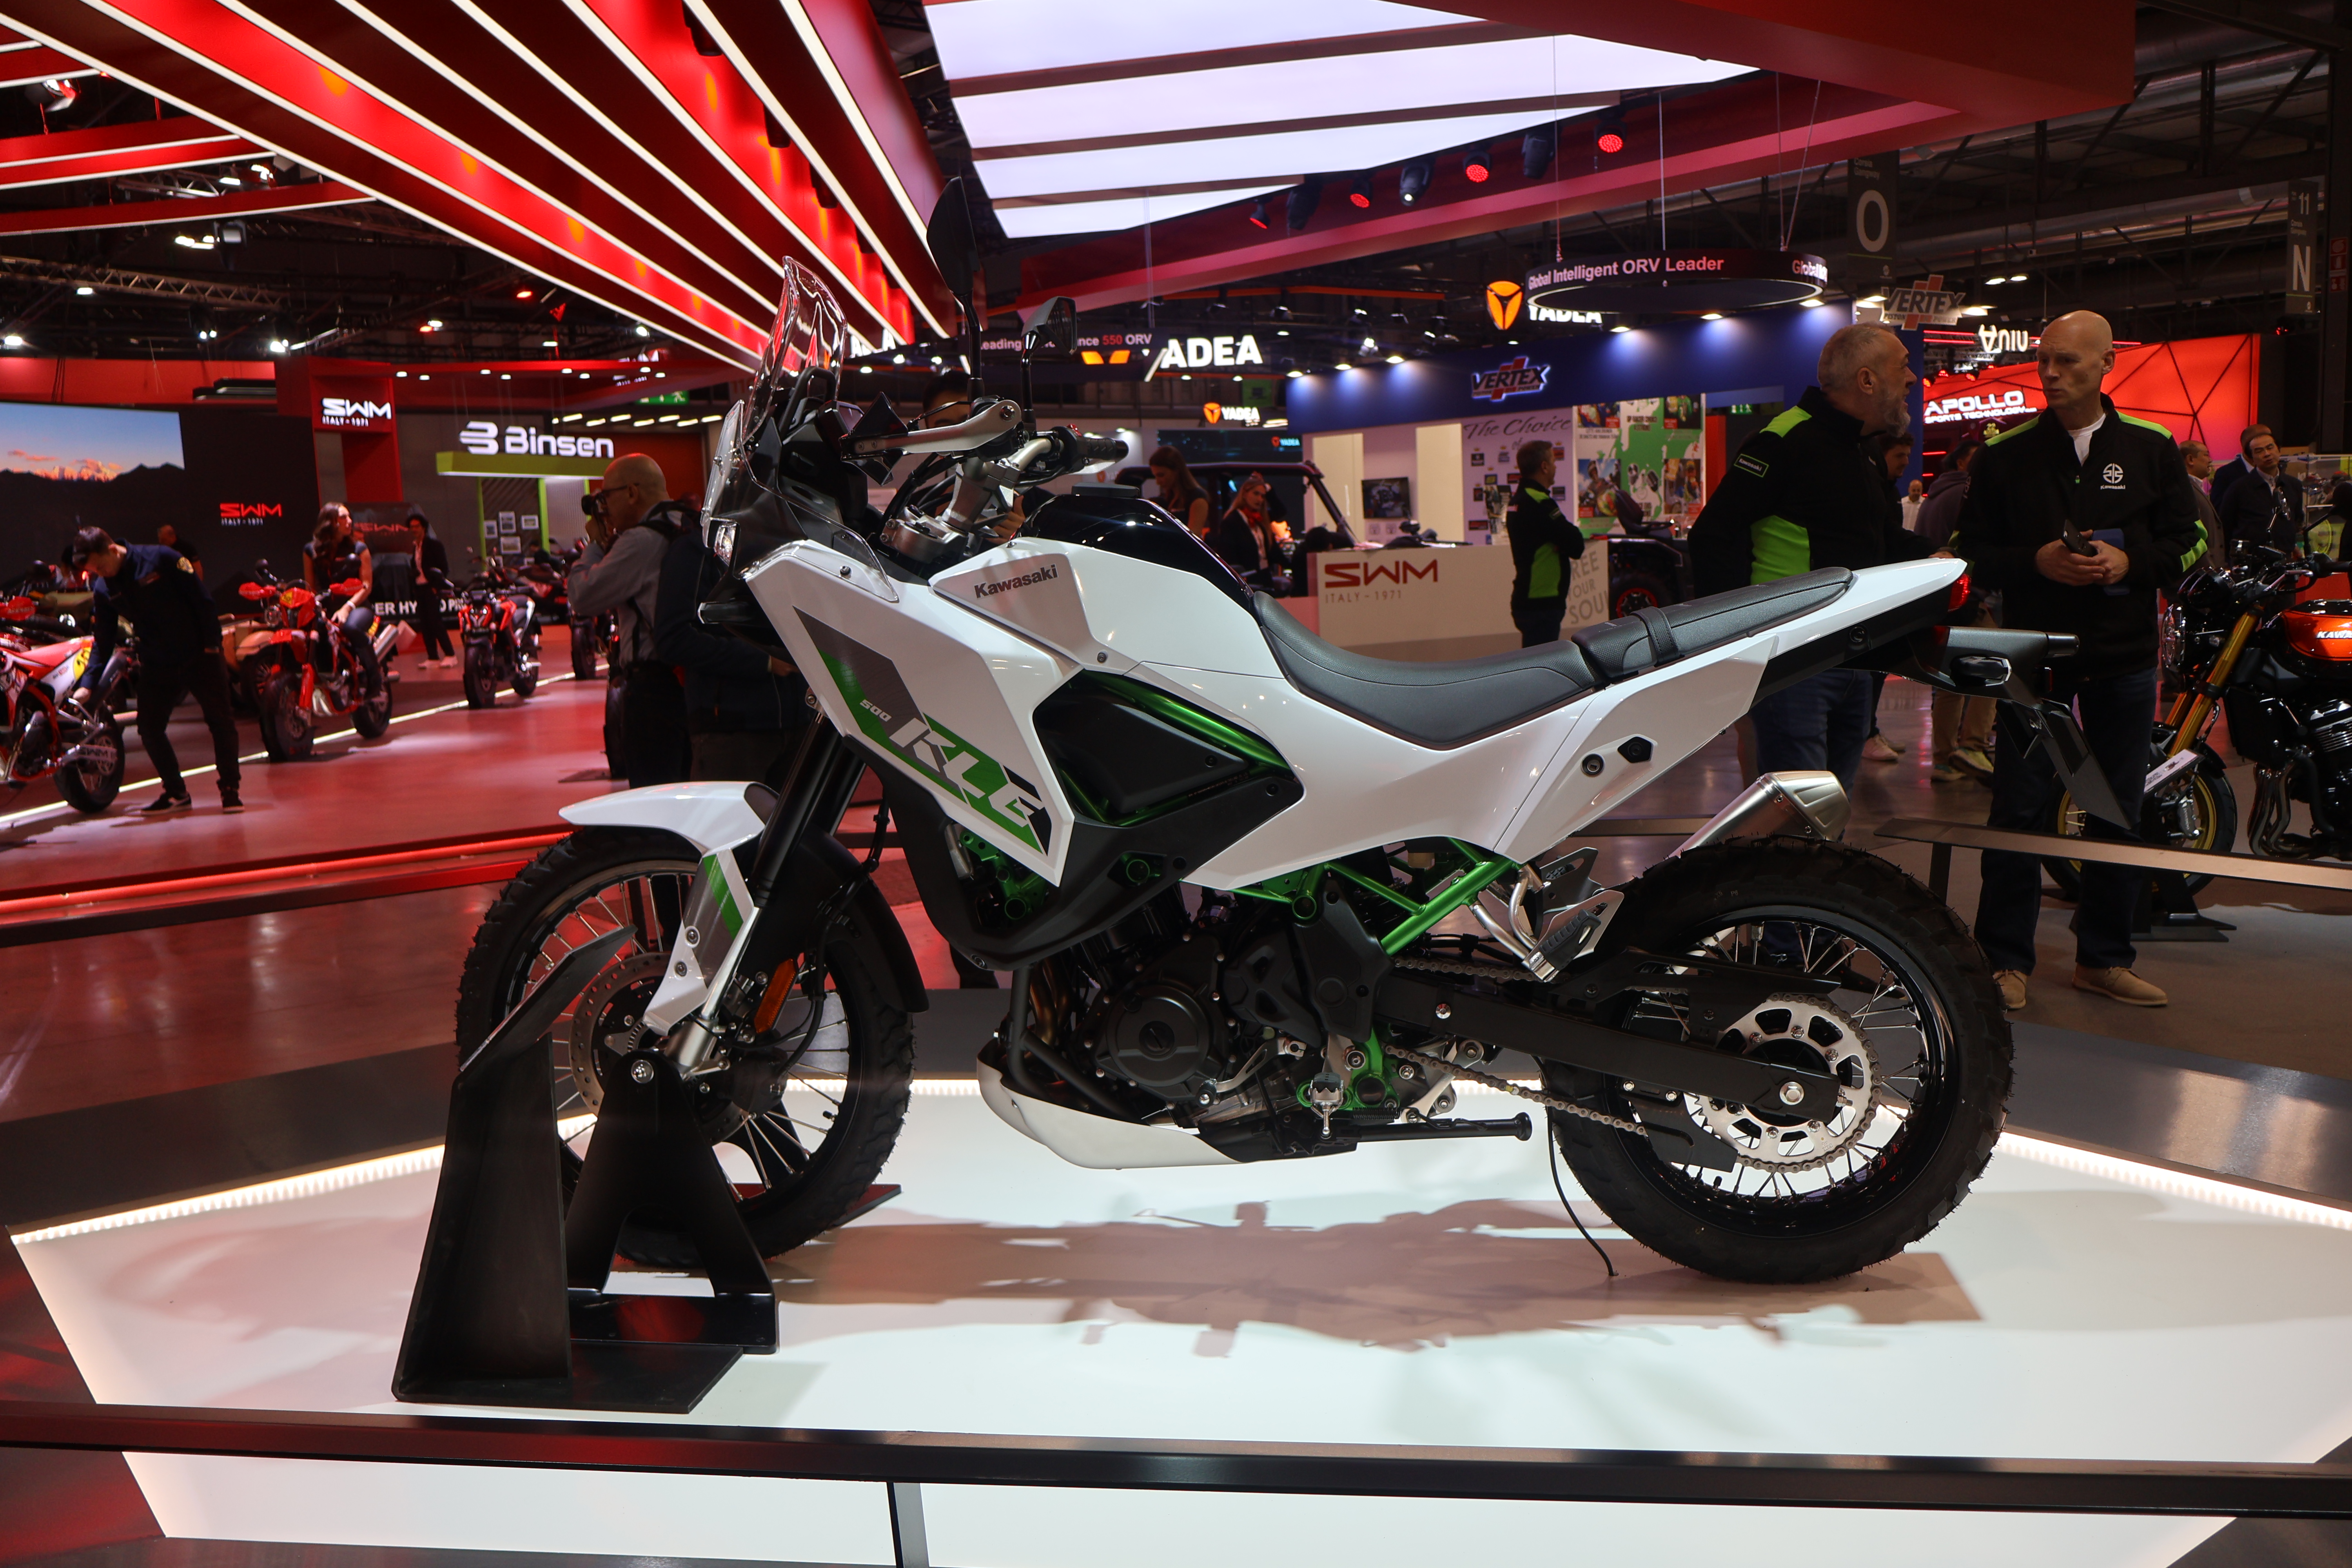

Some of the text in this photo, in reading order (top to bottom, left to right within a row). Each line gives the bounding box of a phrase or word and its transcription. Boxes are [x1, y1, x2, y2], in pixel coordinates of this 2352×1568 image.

[2299, 192, 2310, 215] 11
[1529, 256, 1725, 291] Global Intelligent ORV Leader
[2292, 244, 2311, 292] N
[1882, 287, 1966, 313] VERTEX
[1102, 335, 1123, 345] 550
[1125, 333, 1152, 346] ORV
[1152, 334, 1263, 369] ADEA
[1472, 365, 1550, 390] VERTEX
[322, 397, 392, 419] SWM
[1221, 407, 1261, 421] YADEA
[1924, 390, 2024, 416] APOLLO
[322, 416, 344, 426] ITALY
[1464, 420, 1499, 439] The
[1503, 416, 1571, 436] Choice
[505, 426, 614, 458] Binsen
[1738, 457, 1763, 471] Kawasaki
[220, 503, 282, 517] SWM
[1325, 558, 1438, 588] SWM
[1570, 550, 1599, 580] REE
[974, 564, 1058, 599] Kawasaki
[374, 601, 397, 616] ER
[1325, 592, 1360, 604] ITALY
[1375, 590, 1402, 600] 1971
[860, 699, 892, 722] 500
[889, 717, 1045, 827] KLE
